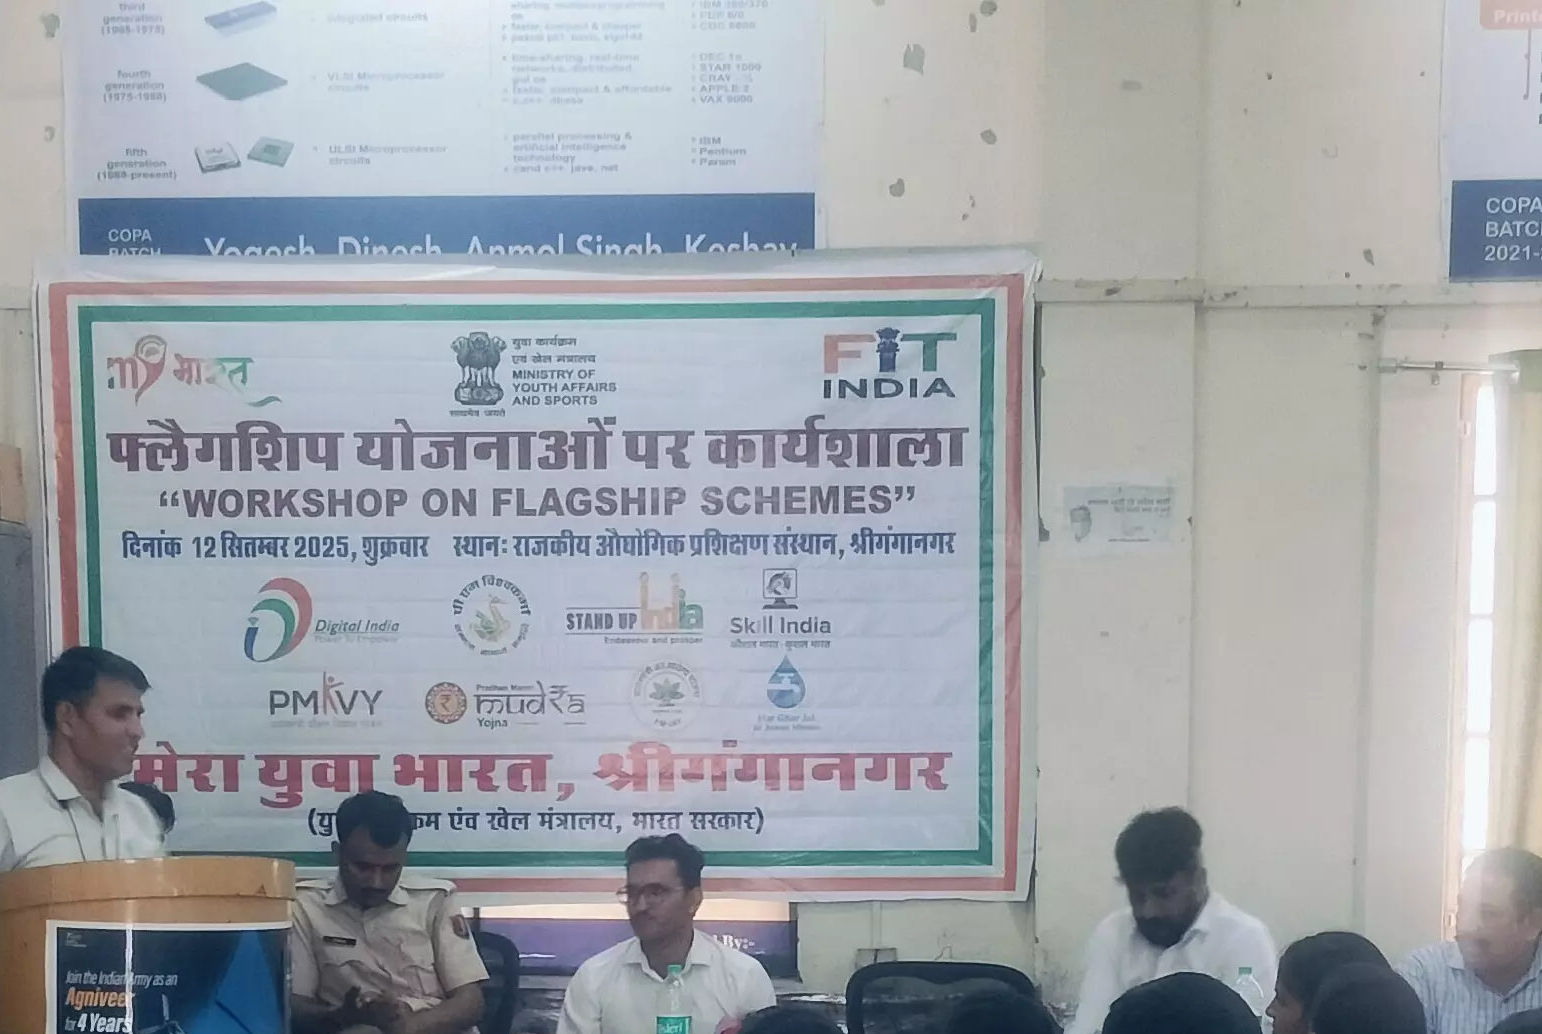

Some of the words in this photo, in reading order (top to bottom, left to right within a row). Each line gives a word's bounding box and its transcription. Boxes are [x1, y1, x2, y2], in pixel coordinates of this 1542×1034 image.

[108, 228, 152, 242] COPA
[512, 369, 574, 381] MINISTRY
[578, 369, 597, 381] OF
[512, 382, 555, 394] YOUTH
[559, 382, 617, 394] AFFAIRS
[823, 377, 956, 399] INDIA
[512, 395, 545, 407] AND
[551, 395, 598, 407] SPORTS
[107, 419, 344, 474] फ्लैगशिप
[354, 416, 617, 472] योजनाओं
[622, 430, 695, 469] पर
[705, 414, 969, 469] कार्यशाला
[422, 488, 476, 517] ON
[493, 487, 687, 517] FLAGSHIP
[122, 529, 183, 559] दिनांक
[192, 536, 217, 558] 12
[220, 530, 290, 559] सितम्बर
[294, 536, 357, 563] 2025,
[362, 535, 430, 567] शुक्रवार
[513, 528, 591, 558] राजकीय
[690, 528, 769, 558] प्रशिक्षण
[773, 526, 846, 561] संस्थान,
[850, 526, 957, 557] श्रीगंगानगर
[315, 618, 361, 637] Digital
[364, 619, 400, 633] India
[566, 612, 614, 631] STAND
[618, 612, 638, 631] UP
[730, 617, 774, 635] Skill
[780, 616, 832, 635] India
[268, 670, 383, 717] PMKVY
[477, 717, 509, 730] Yojna
[133, 741, 246, 793] मेरा
[255, 754, 380, 809] युवा
[394, 753, 576, 802] भारत,
[593, 739, 953, 791] श्रीगंगानगर
[488, 805, 529, 832] खेल
[538, 807, 622, 834] मंत्रालय,
[632, 811, 682, 832] भारत
[689, 806, 763, 835] सरकार)
[65, 970, 82, 985] Join
[77, 1013, 89, 1032] 4
[89, 1012, 132, 1034] Years
